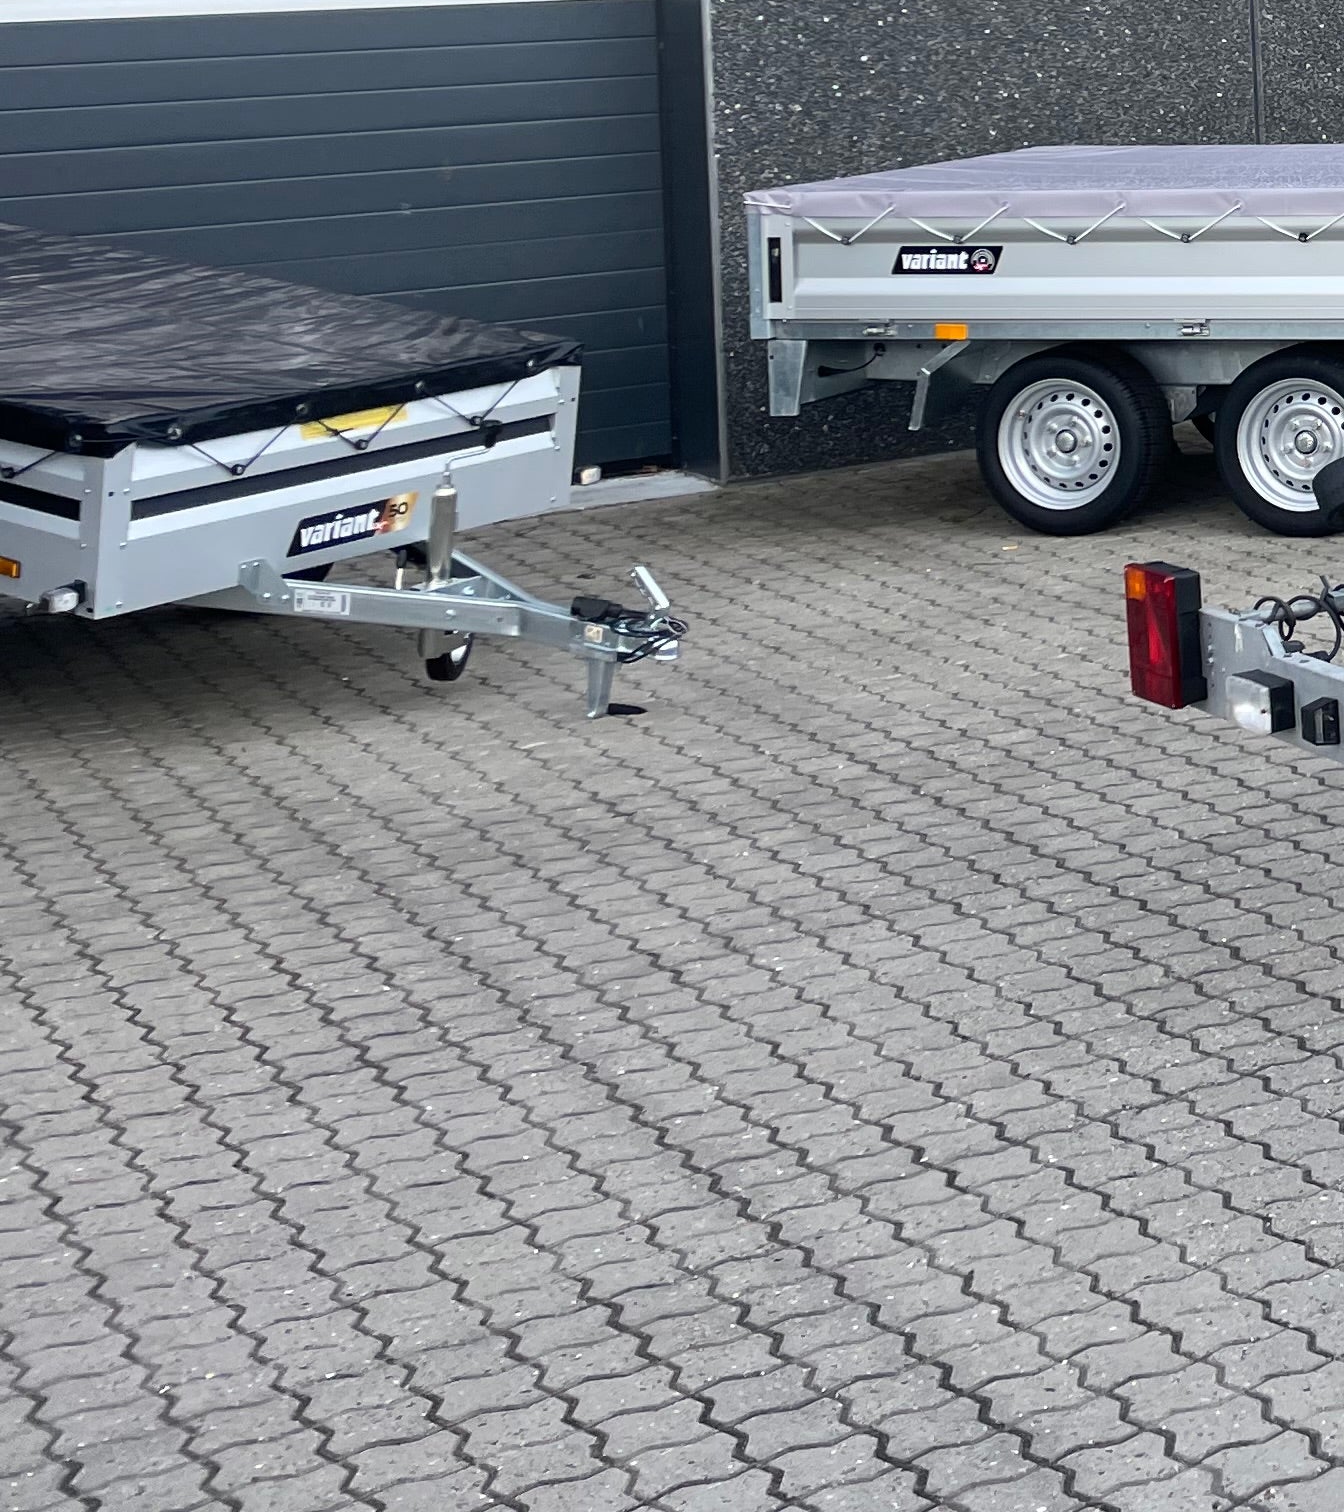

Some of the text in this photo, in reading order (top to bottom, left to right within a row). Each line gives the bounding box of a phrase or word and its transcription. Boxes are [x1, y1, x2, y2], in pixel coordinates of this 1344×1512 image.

[901, 248, 969, 270] variant
[300, 501, 409, 548] variant 50
